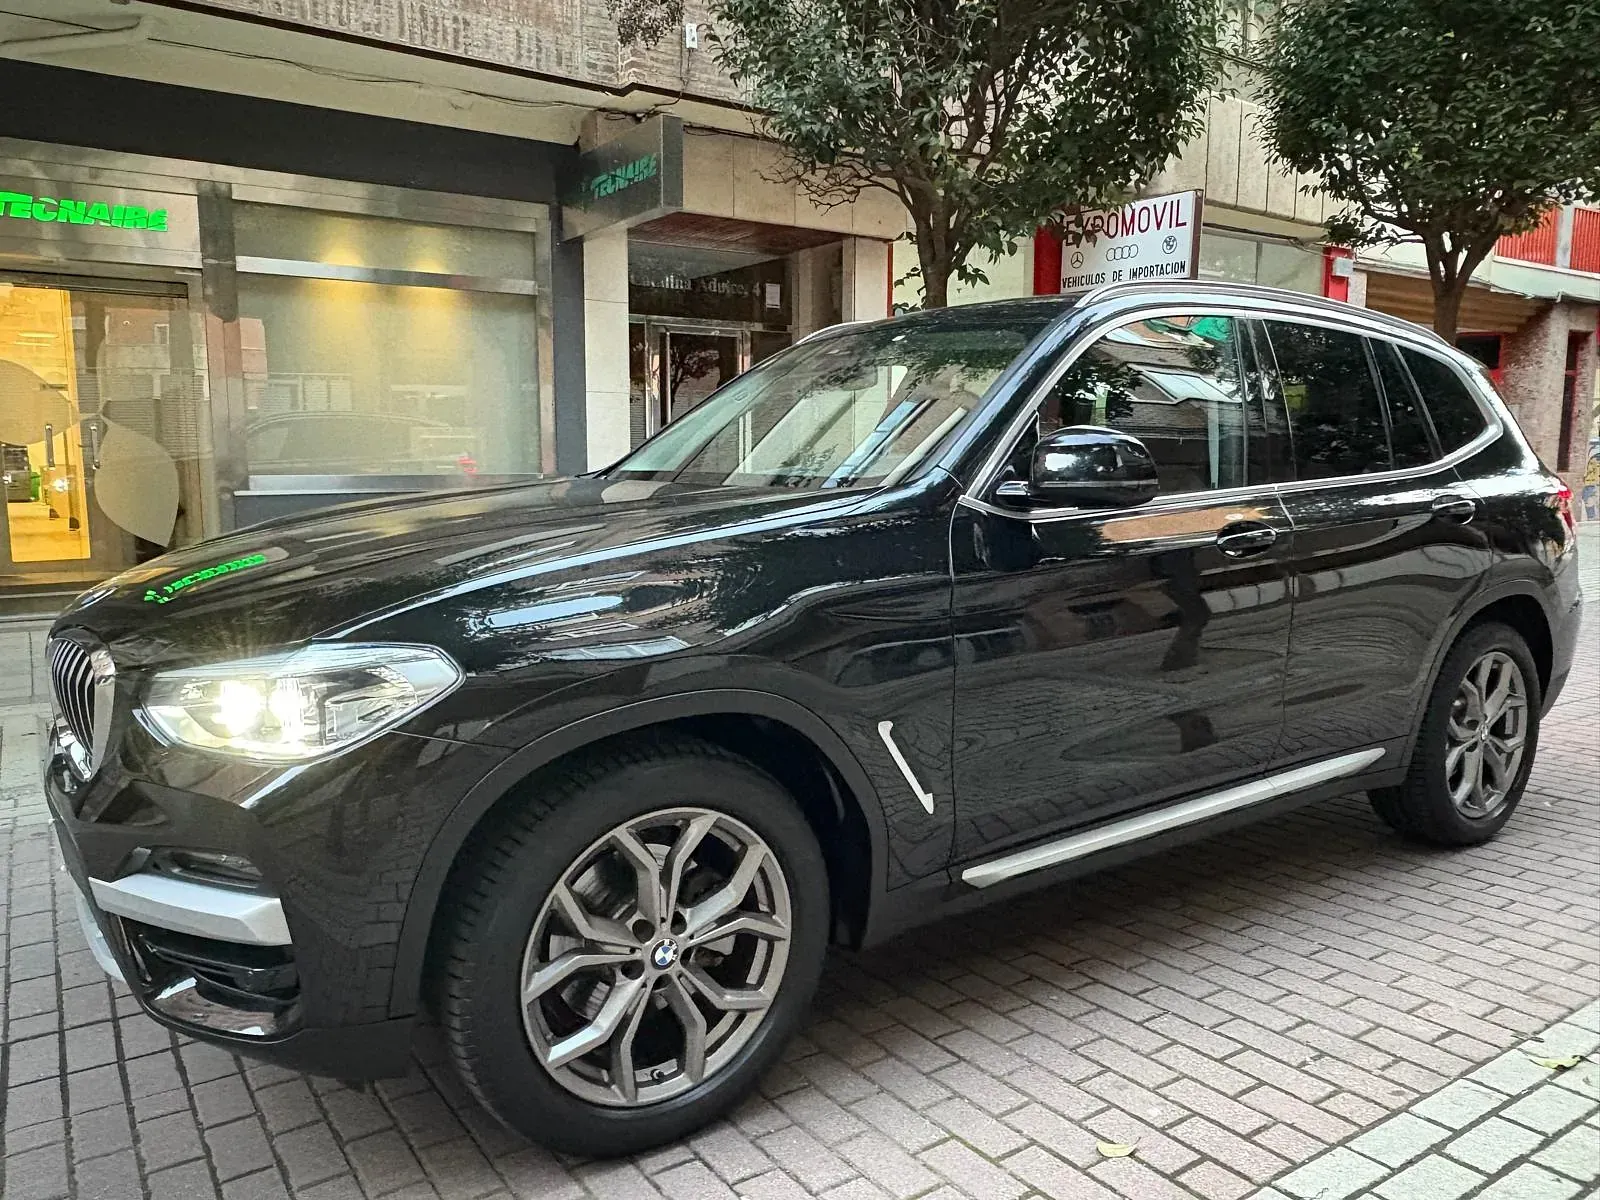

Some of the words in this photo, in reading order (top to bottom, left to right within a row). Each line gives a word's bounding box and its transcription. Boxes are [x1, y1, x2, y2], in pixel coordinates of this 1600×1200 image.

[1062, 272, 1106, 289] VEHICULOS
[1112, 269, 1123, 283] DE
[1129, 260, 1186, 279] IMPORTACION
